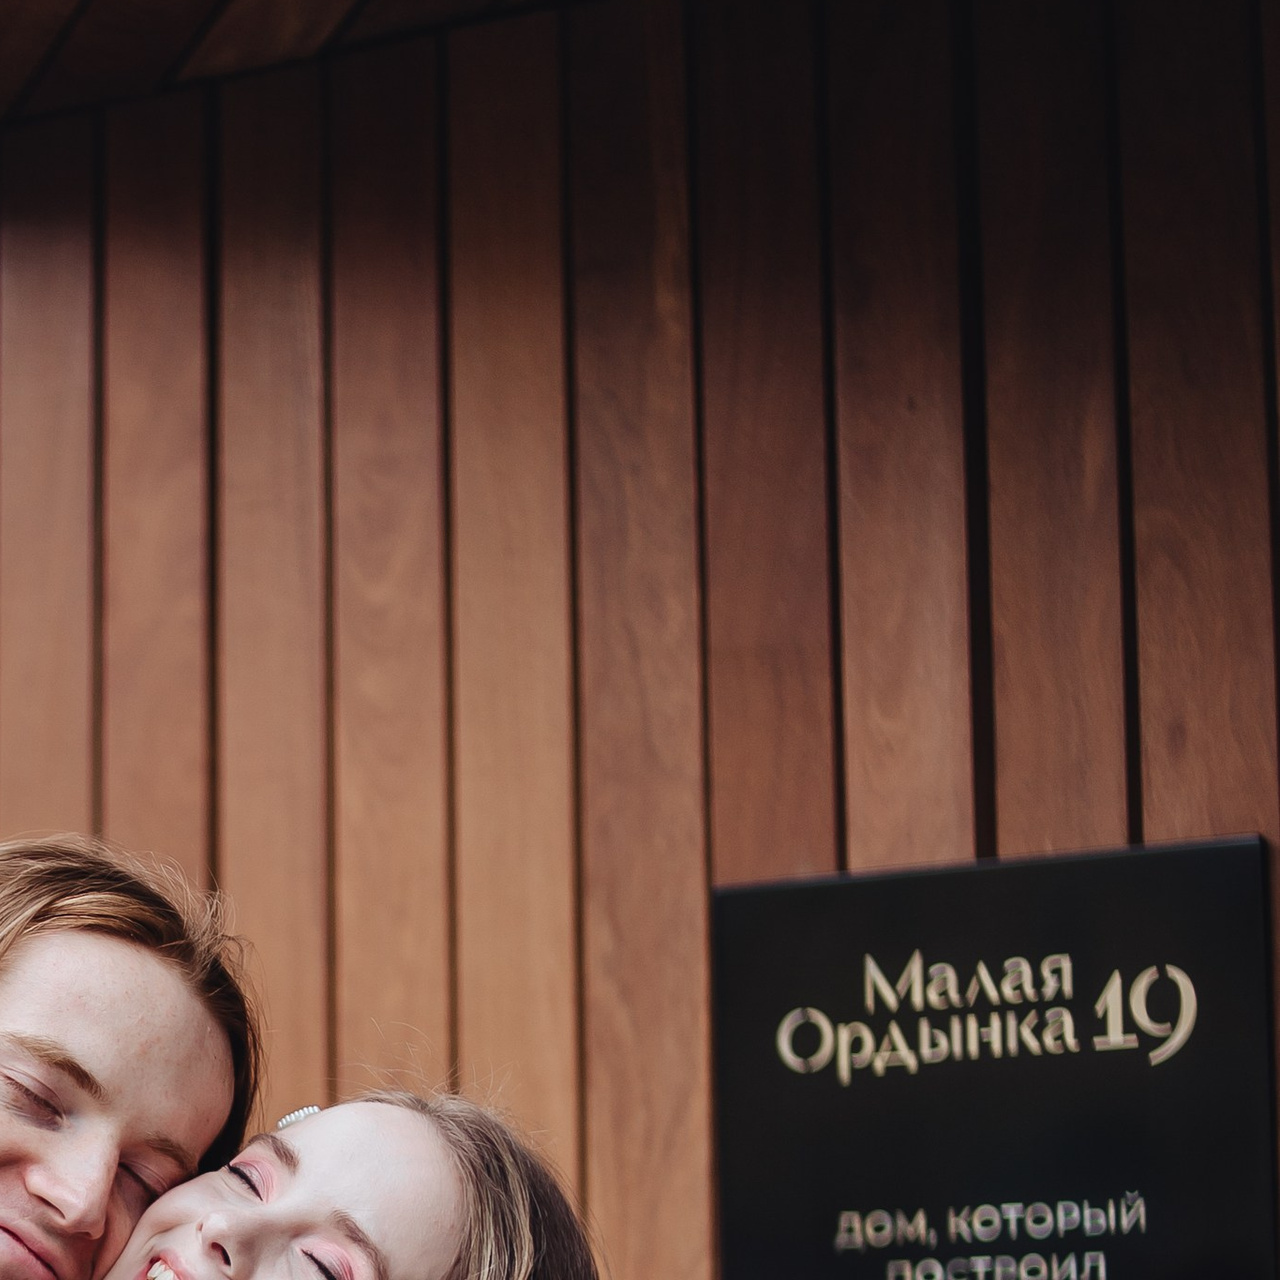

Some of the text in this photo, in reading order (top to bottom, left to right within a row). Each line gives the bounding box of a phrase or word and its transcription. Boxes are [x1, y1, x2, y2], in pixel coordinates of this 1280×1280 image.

[863, 948, 1074, 1015] Малая
[776, 963, 1198, 1087] Ордынка 19
[946, 1189, 1147, 1245] КОТОРЫЙ
